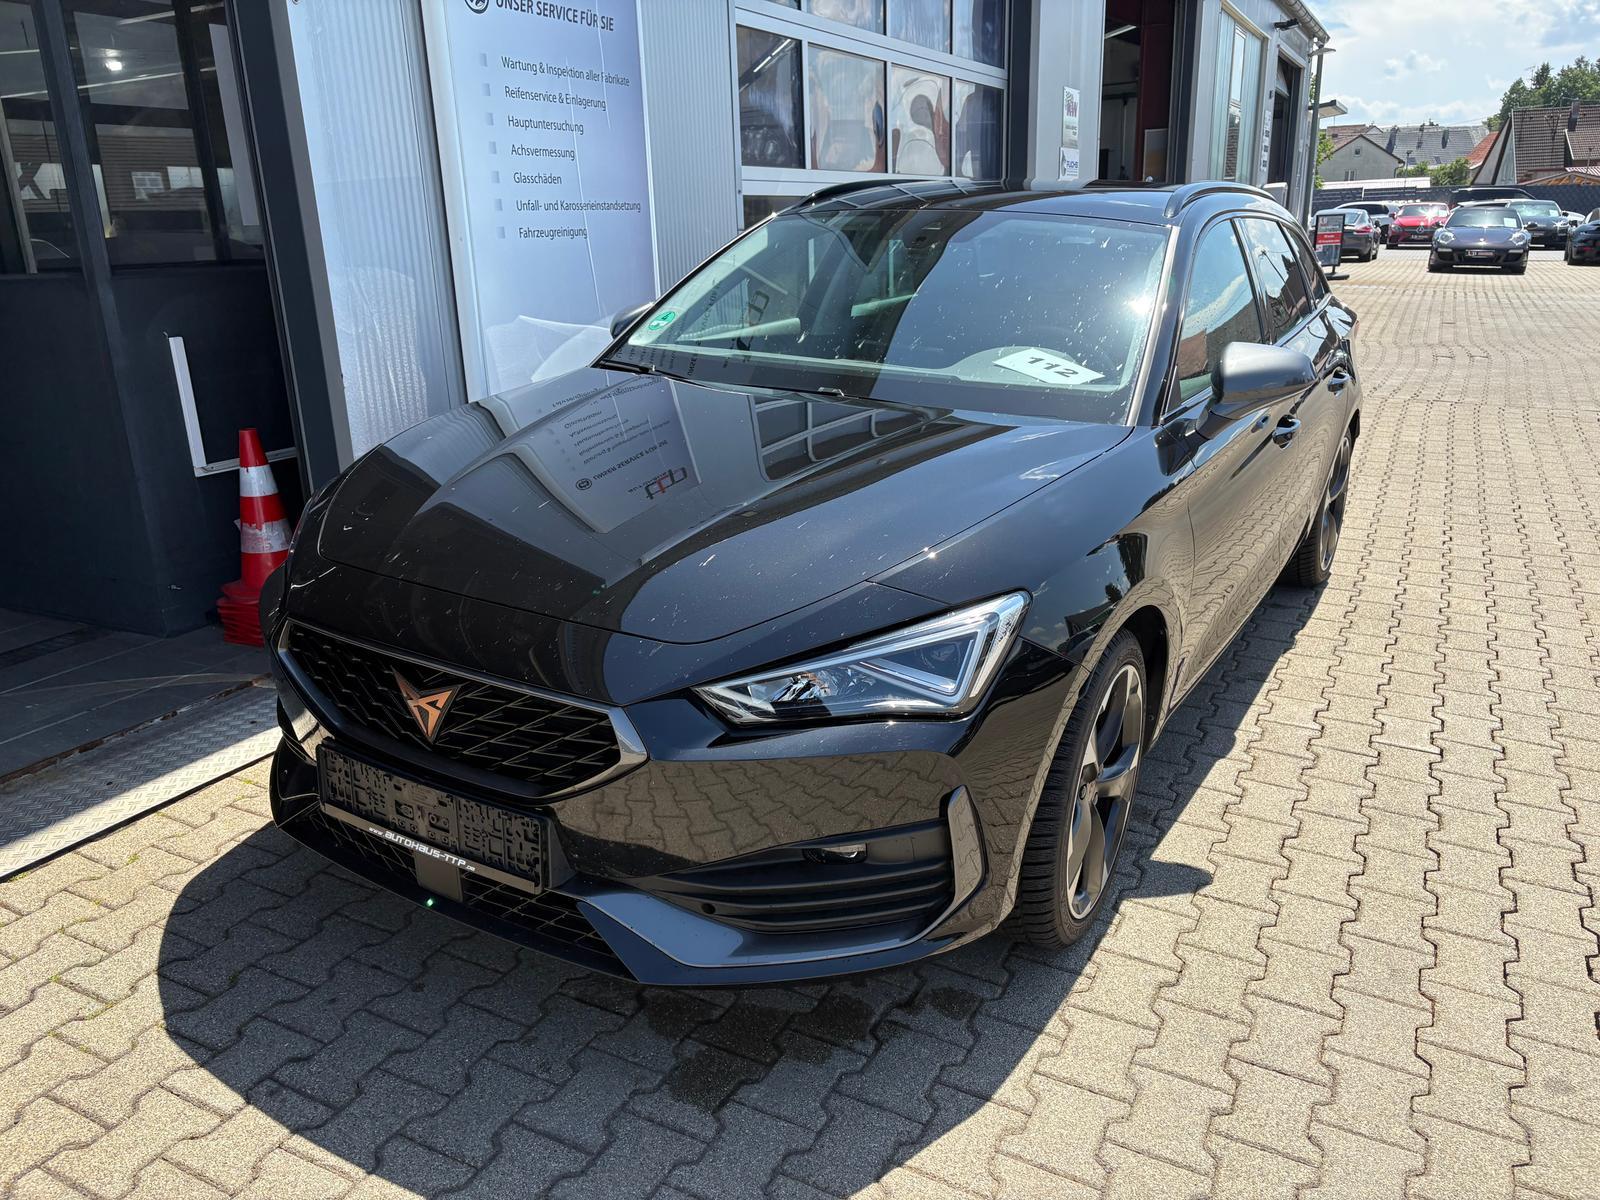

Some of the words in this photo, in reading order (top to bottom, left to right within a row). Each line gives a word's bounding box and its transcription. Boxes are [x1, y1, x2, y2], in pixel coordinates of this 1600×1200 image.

[496, 0, 533, 14] UNSER
[536, 1, 578, 24] SERVICE
[580, 11, 599, 28] FÜR
[600, 16, 614, 31] SIE
[501, 56, 537, 75] Wartung
[539, 63, 545, 73] &
[546, 64, 585, 79] Inspektion
[585, 69, 600, 81] aller
[601, 72, 630, 86] Fabrikate
[505, 86, 557, 104] Reifenservice
[558, 93, 564, 103] &
[565, 94, 606, 111] Einlagerung
[508, 115, 584, 135] Hauptuntersuchung
[511, 144, 575, 161] Achsvermessung
[513, 172, 562, 185] Glasschäden
[516, 200, 542, 211] Unfall-
[544, 200, 559, 211] und
[519, 227, 588, 240] Fahrzeugreinigung
[1027, 356, 1079, 378] 112
